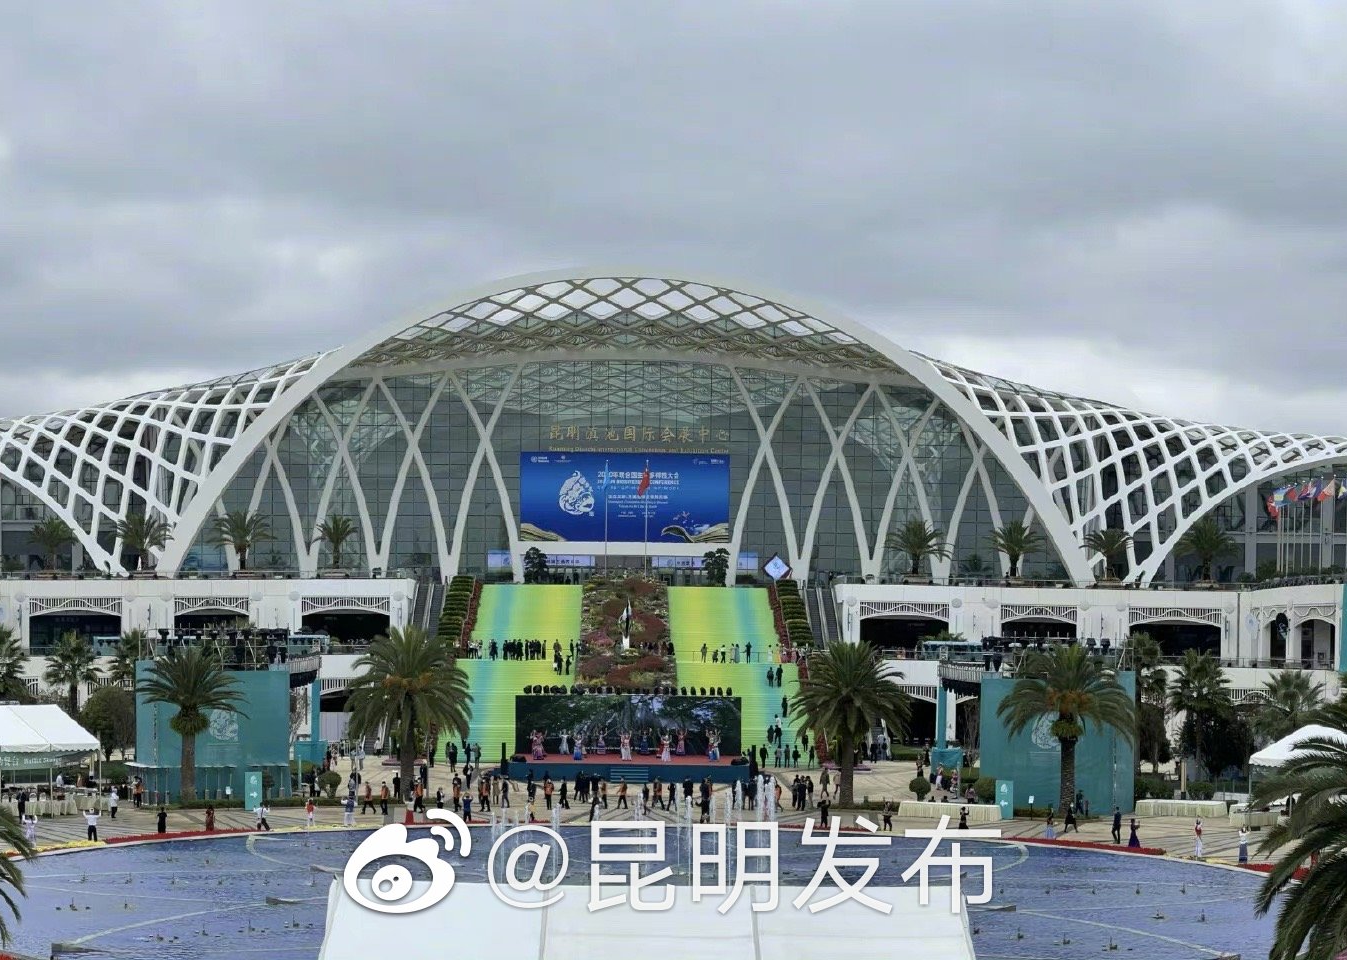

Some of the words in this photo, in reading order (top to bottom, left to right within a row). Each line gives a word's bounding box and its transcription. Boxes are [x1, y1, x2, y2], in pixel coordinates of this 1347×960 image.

[549, 425, 730, 443] 昆明滇池国际会展中心
